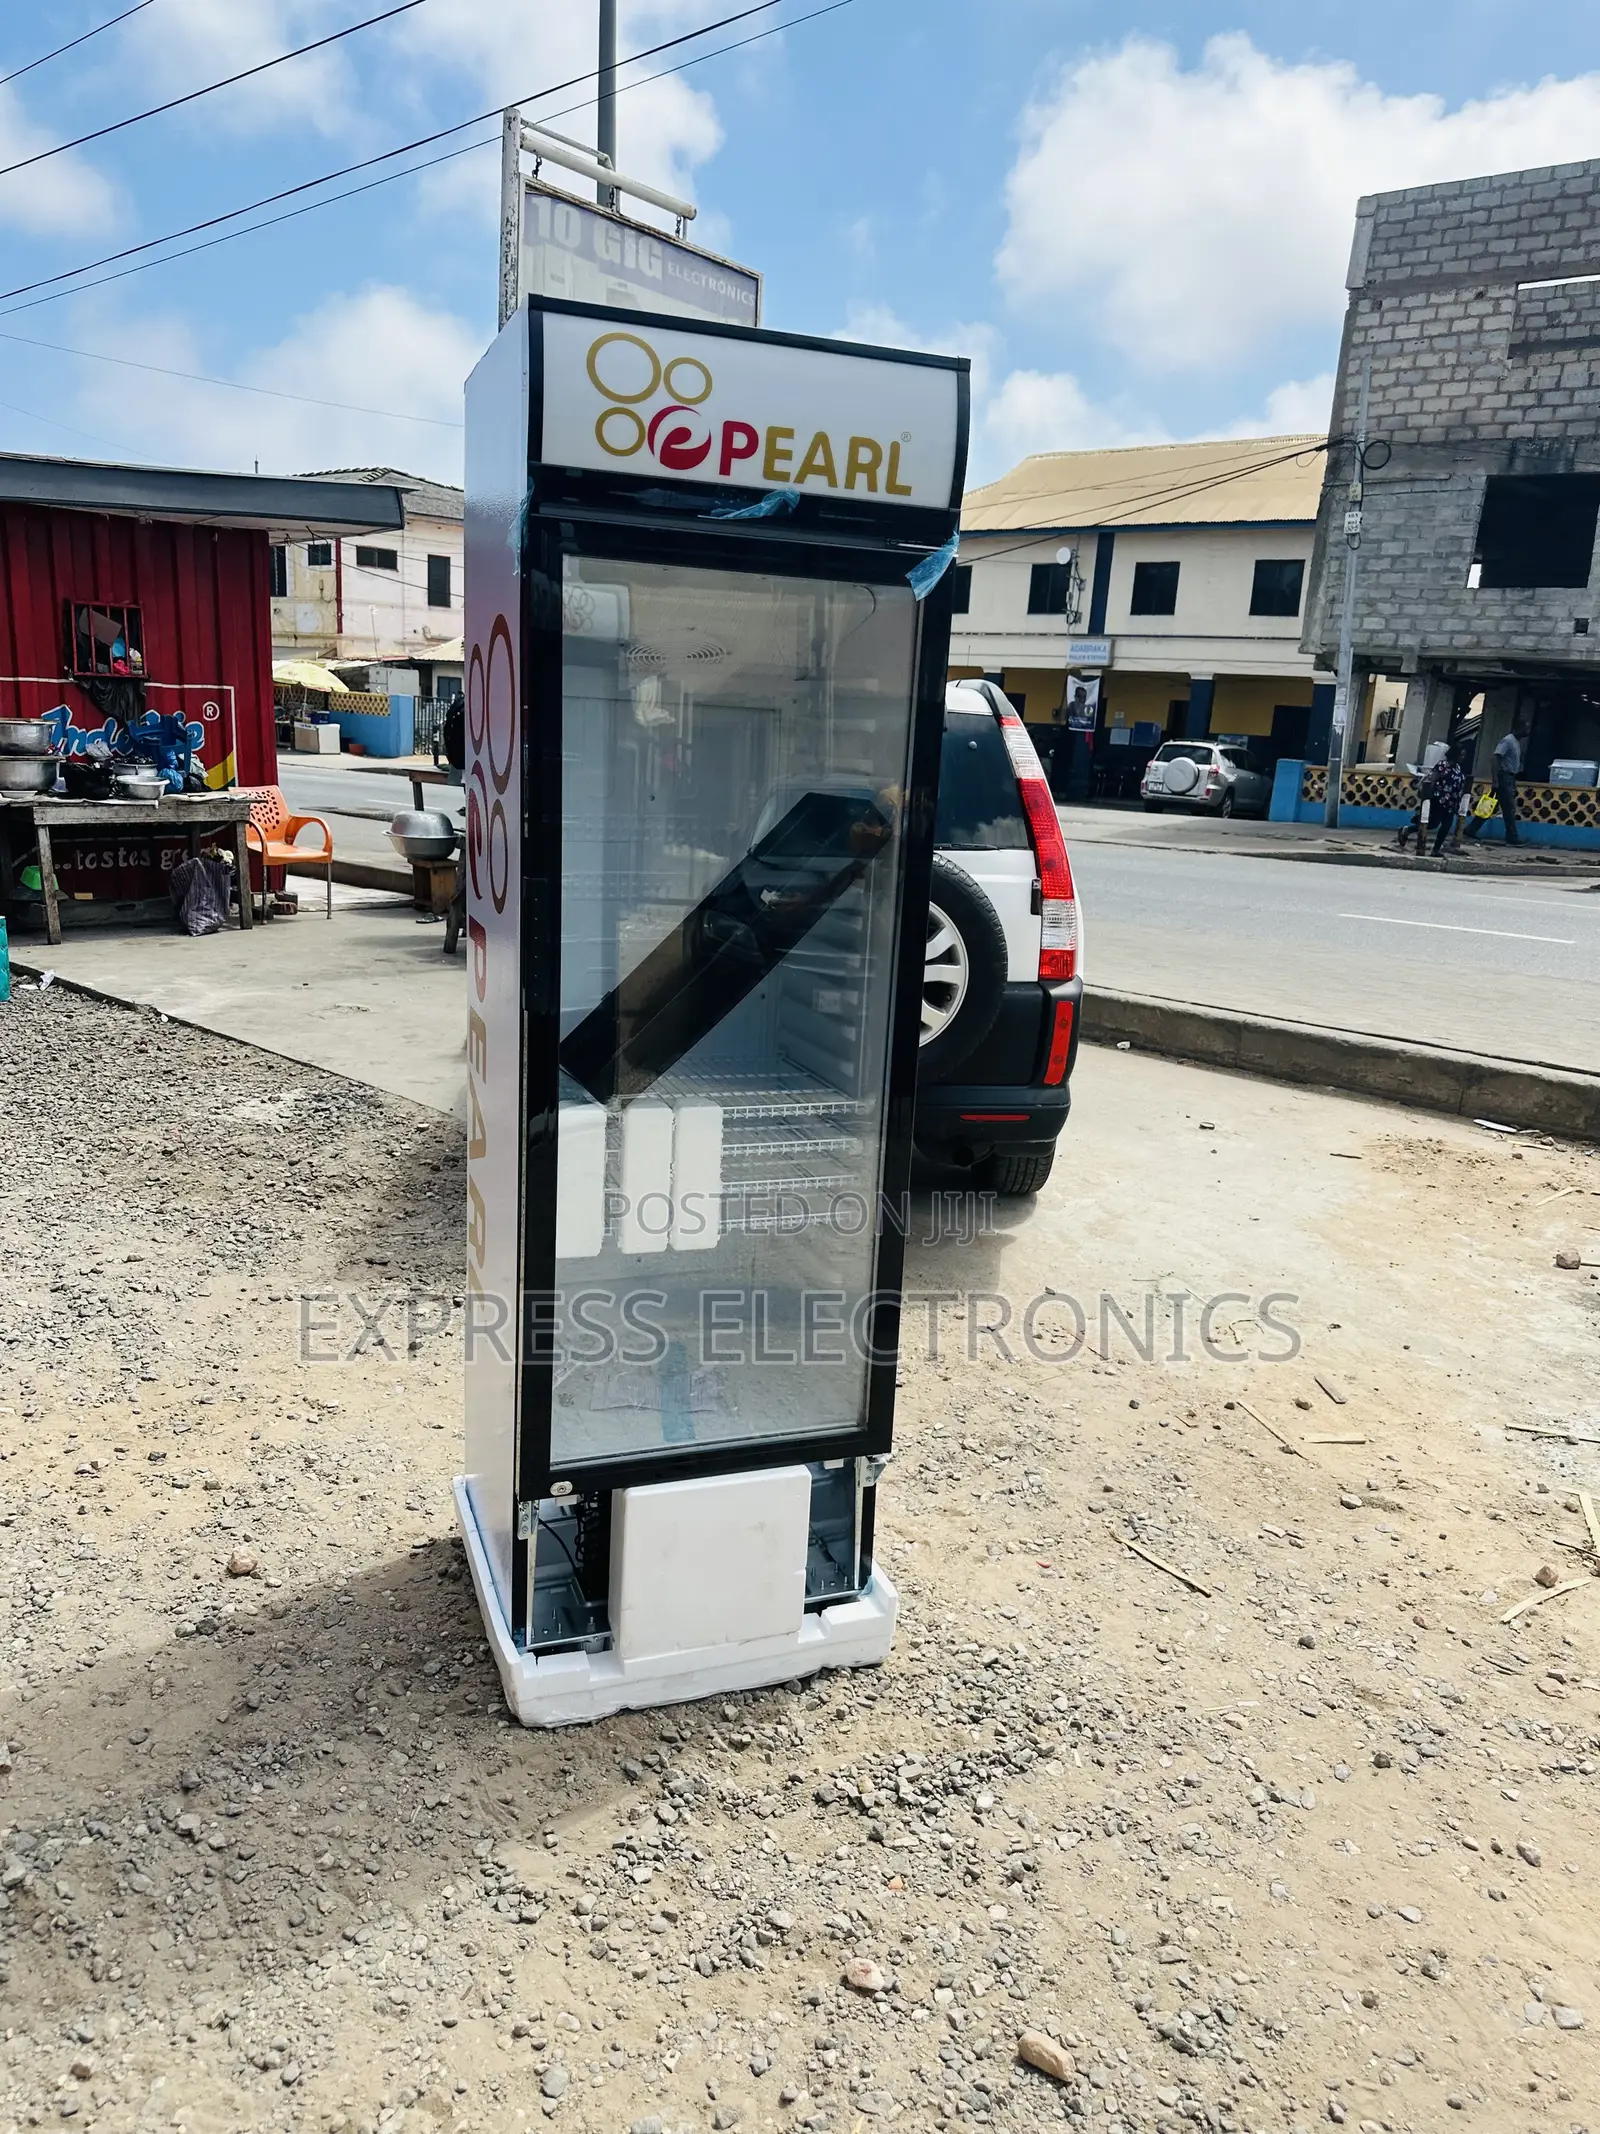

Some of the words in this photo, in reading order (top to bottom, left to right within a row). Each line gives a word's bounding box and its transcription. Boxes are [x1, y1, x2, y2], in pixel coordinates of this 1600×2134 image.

[531, 197, 582, 249] 10
[594, 219, 664, 281] GIG
[667, 260, 756, 307] ELECTRONICS
